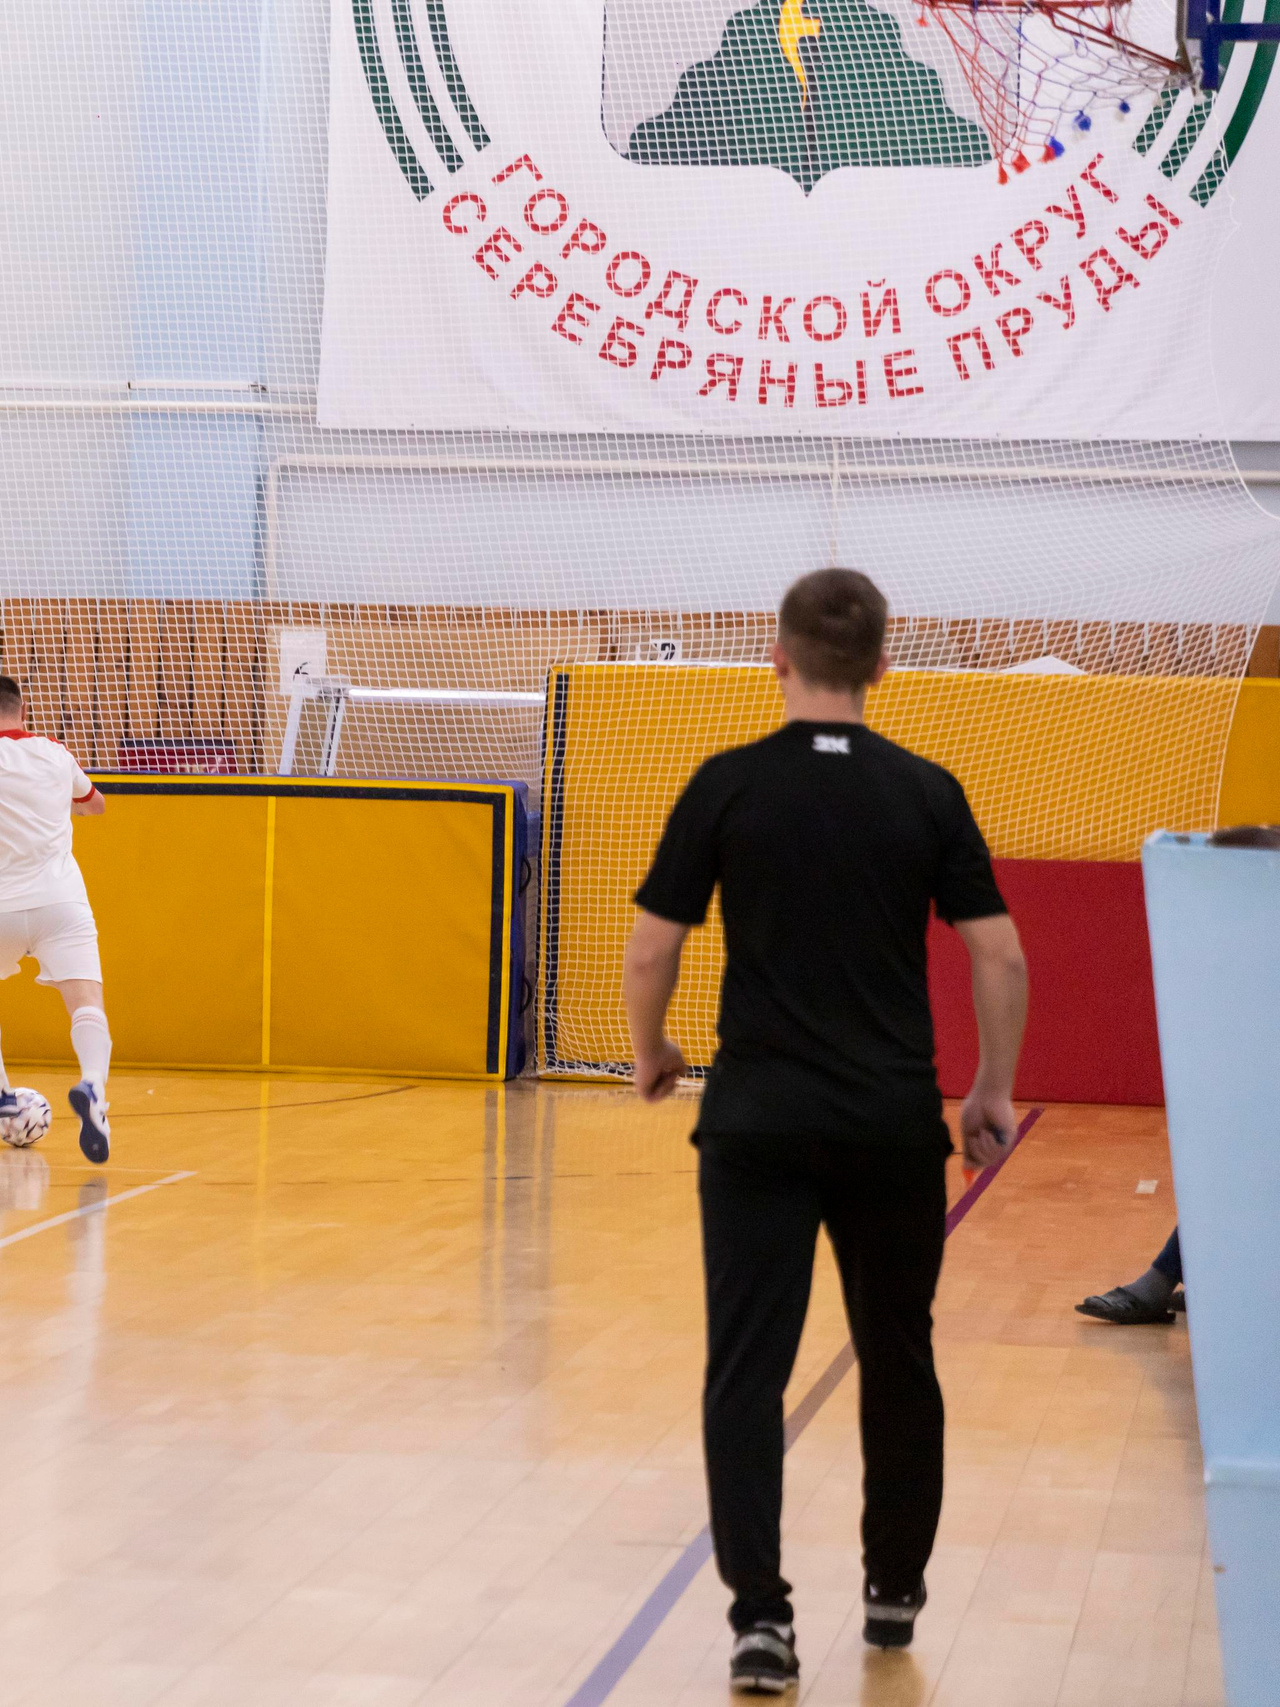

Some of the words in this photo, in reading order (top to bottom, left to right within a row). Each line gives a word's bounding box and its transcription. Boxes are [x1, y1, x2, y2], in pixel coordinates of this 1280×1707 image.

[442, 190, 925, 408] СЕРЕБРЯНЫЕ
[946, 193, 1183, 381] ПРУДЫ
[491, 153, 902, 343] ГОРОДСКОЙ
[925, 152, 1120, 318] ОКРУГ
